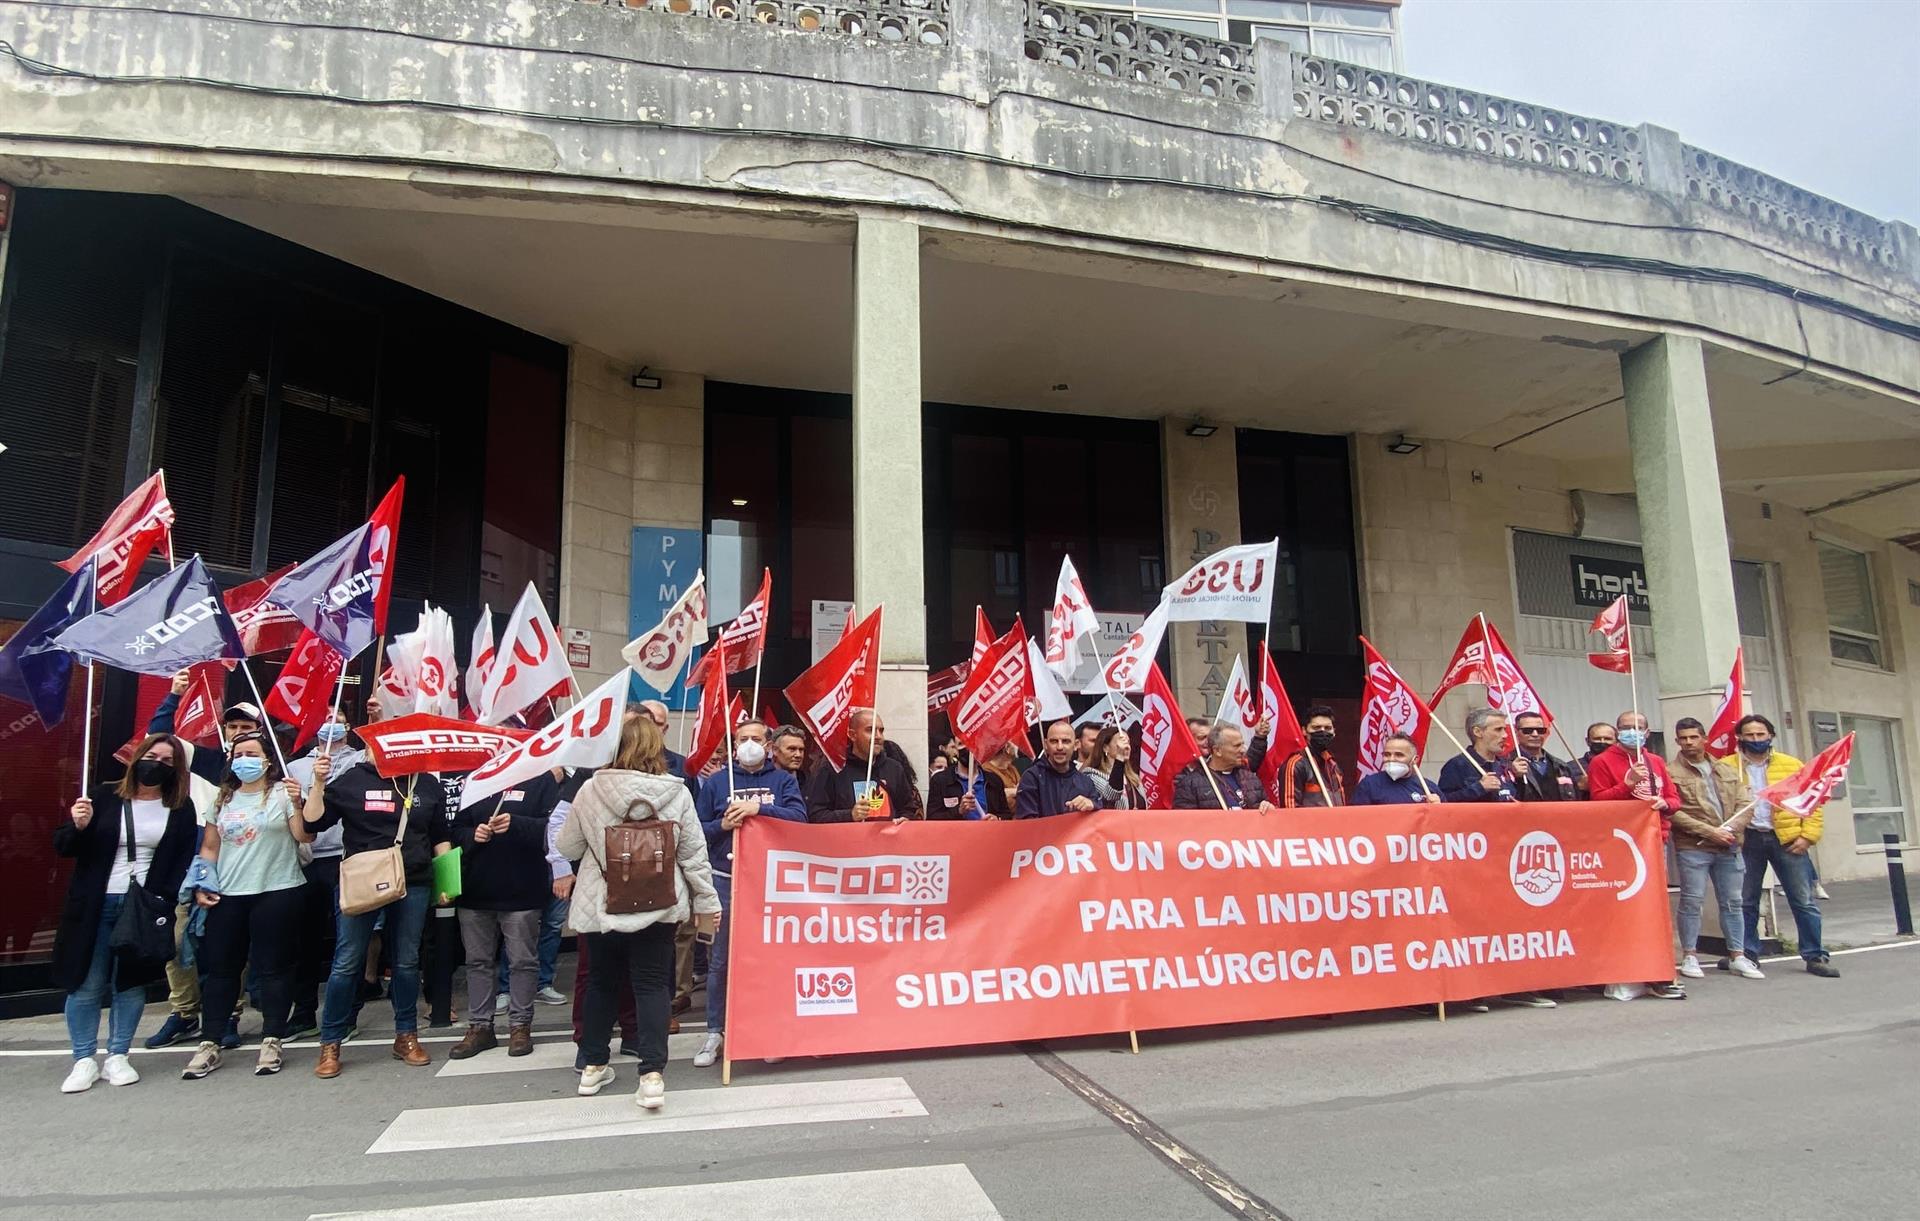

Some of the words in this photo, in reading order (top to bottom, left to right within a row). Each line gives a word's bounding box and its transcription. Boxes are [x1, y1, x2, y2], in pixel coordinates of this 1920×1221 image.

[1581, 589, 1649, 605] TAPICRIA
[1010, 843, 1097, 878] POR
[1106, 840, 1164, 872] UN
[1177, 836, 1376, 870] CONVENIO
[1386, 831, 1488, 863] DIGNO
[1517, 845, 1557, 873] UGT
[1570, 852, 1603, 869] FICA
[776, 861, 902, 895] CCOO
[763, 906, 947, 944] industria
[1079, 897, 1185, 933] PARA
[1195, 895, 1246, 927] LA
[1257, 886, 1449, 925] INDUSTRIA
[797, 972, 853, 998] USO
[895, 947, 1341, 1009] SIDEROMETALÚRGICA
[1351, 944, 1396, 976] DE
[1406, 930, 1576, 971] CANTABRIA
